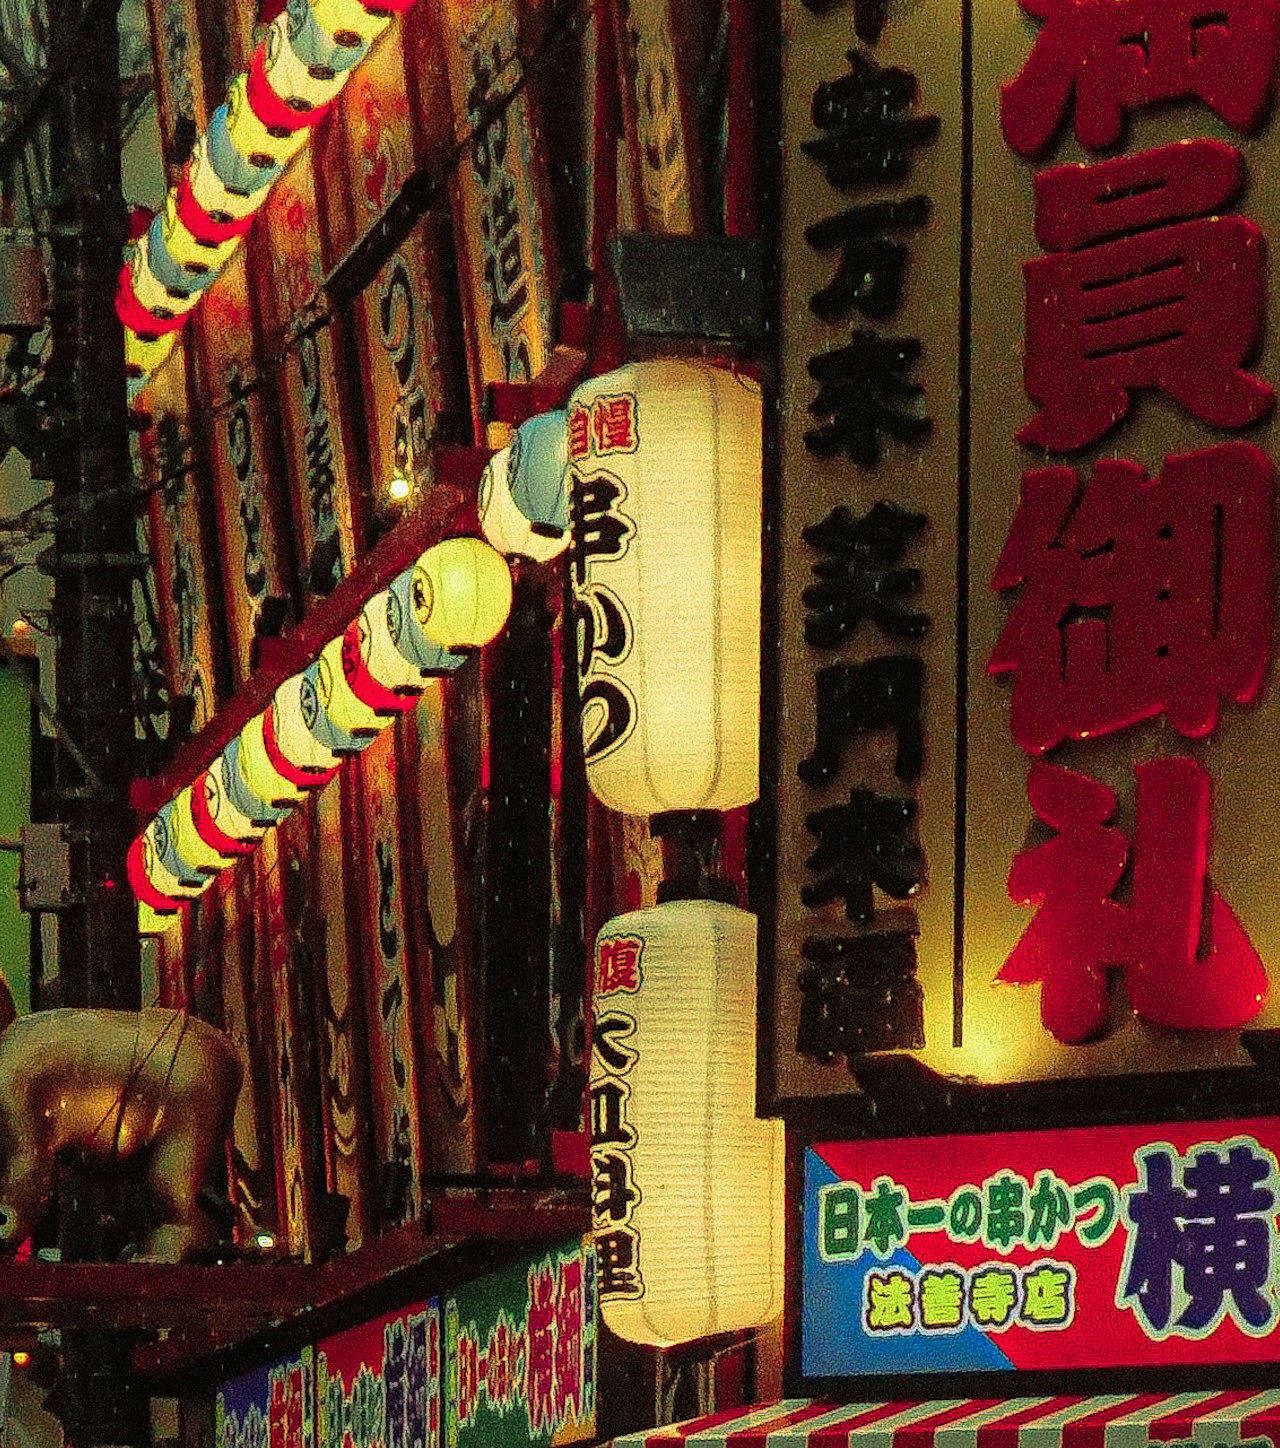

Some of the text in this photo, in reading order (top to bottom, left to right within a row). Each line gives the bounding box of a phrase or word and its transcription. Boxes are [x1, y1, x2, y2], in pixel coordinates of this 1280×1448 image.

[821, 1170, 1117, 1258] 日本一の串かつ
[866, 1266, 1074, 1332] 法善寺店
